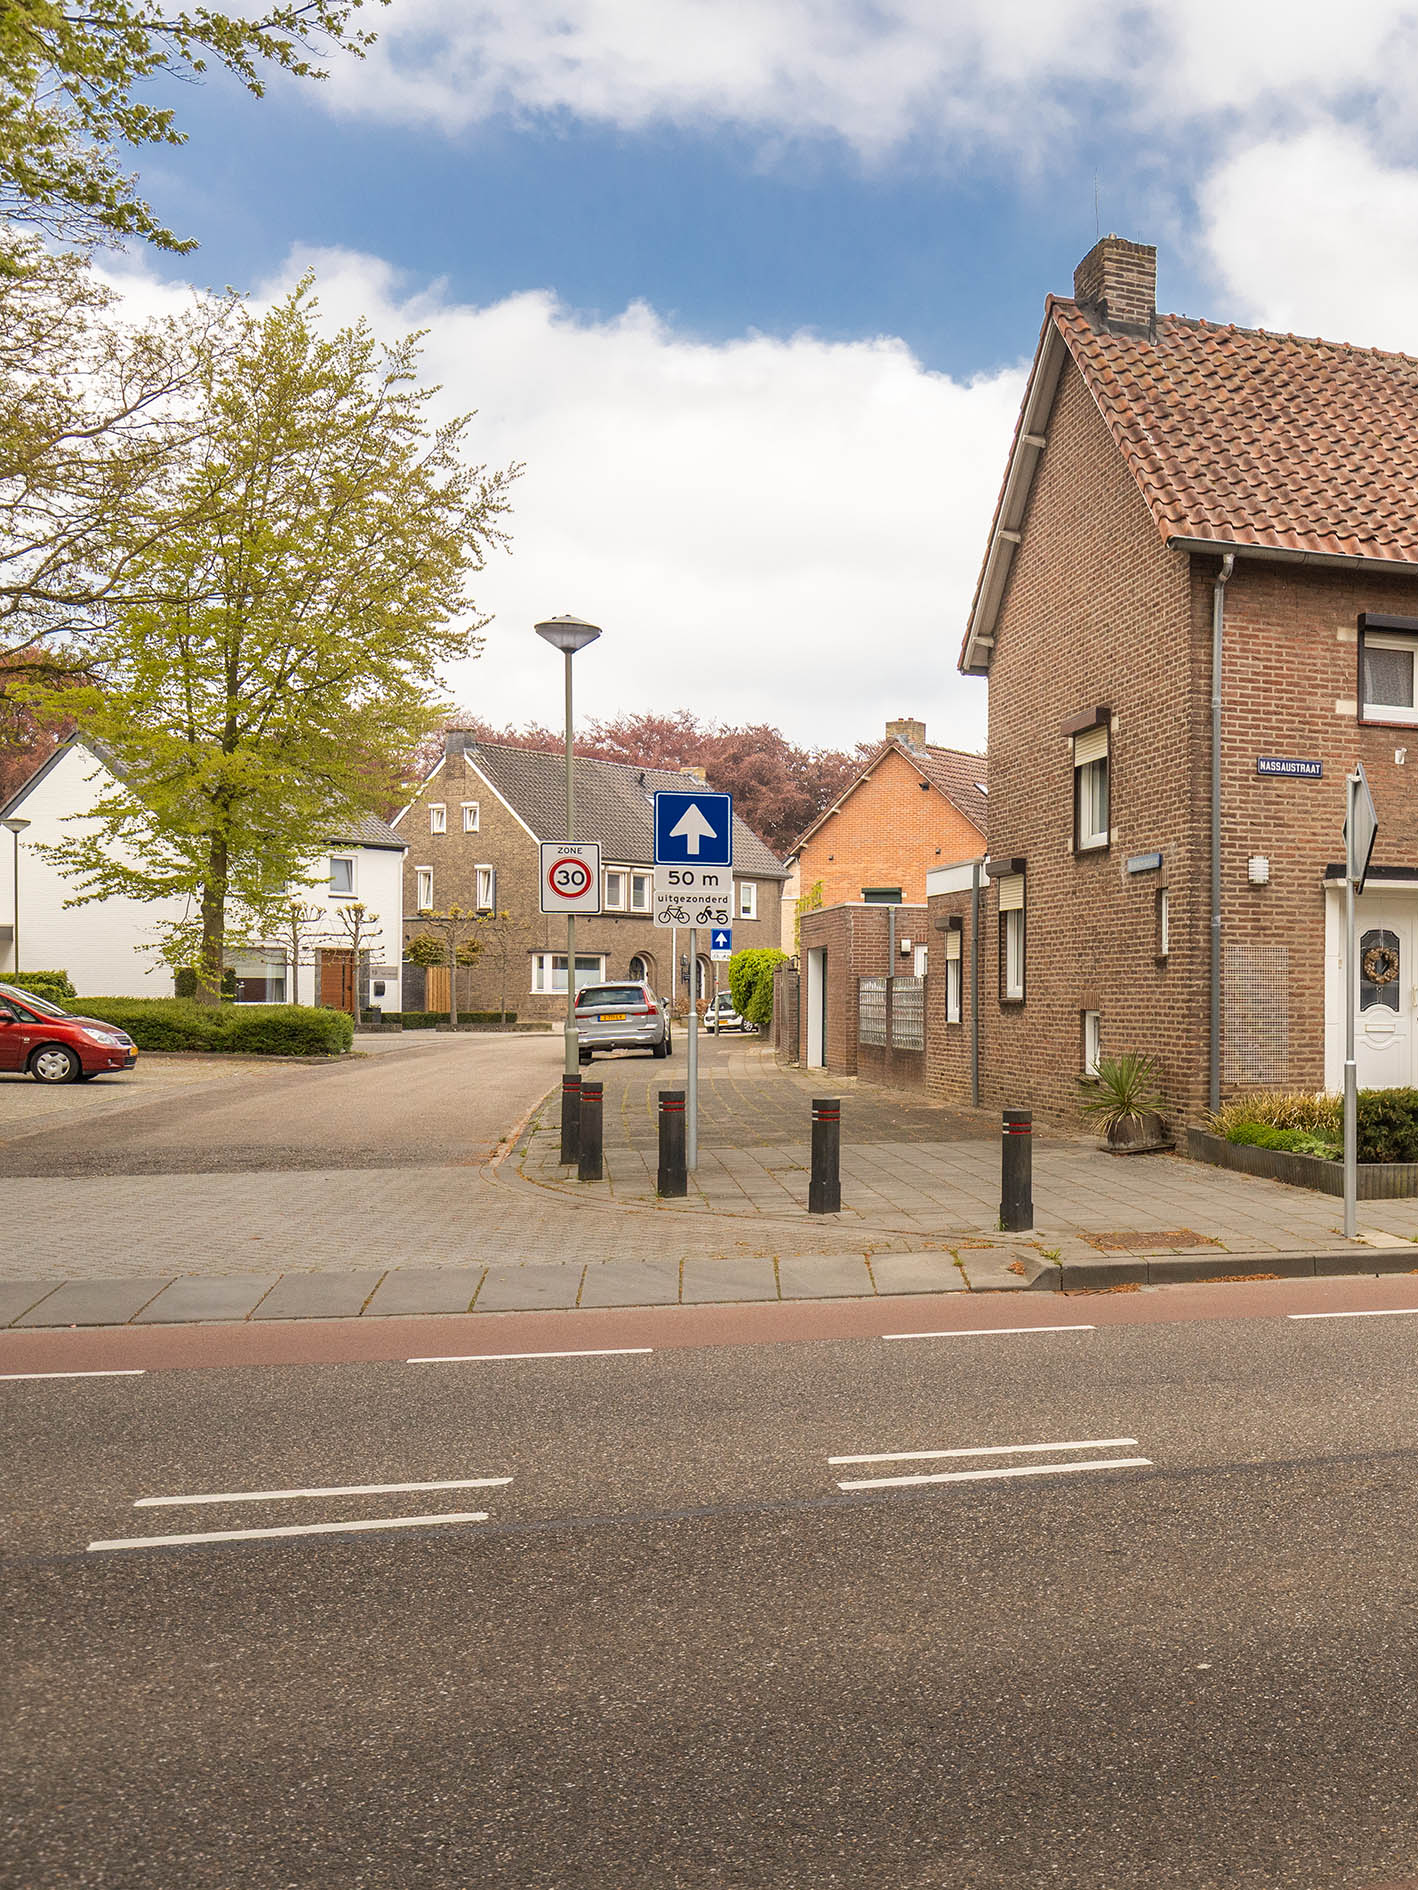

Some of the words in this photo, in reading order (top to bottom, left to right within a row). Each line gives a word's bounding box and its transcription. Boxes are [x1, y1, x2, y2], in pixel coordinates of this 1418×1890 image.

[1260, 761, 1321, 773] NASSAUSTRAAT
[557, 847, 583, 855] ZONE
[557, 870, 585, 886] 30
[668, 871, 694, 886] 50
[702, 874, 719, 886] m
[658, 895, 729, 904] uitgezonderd
